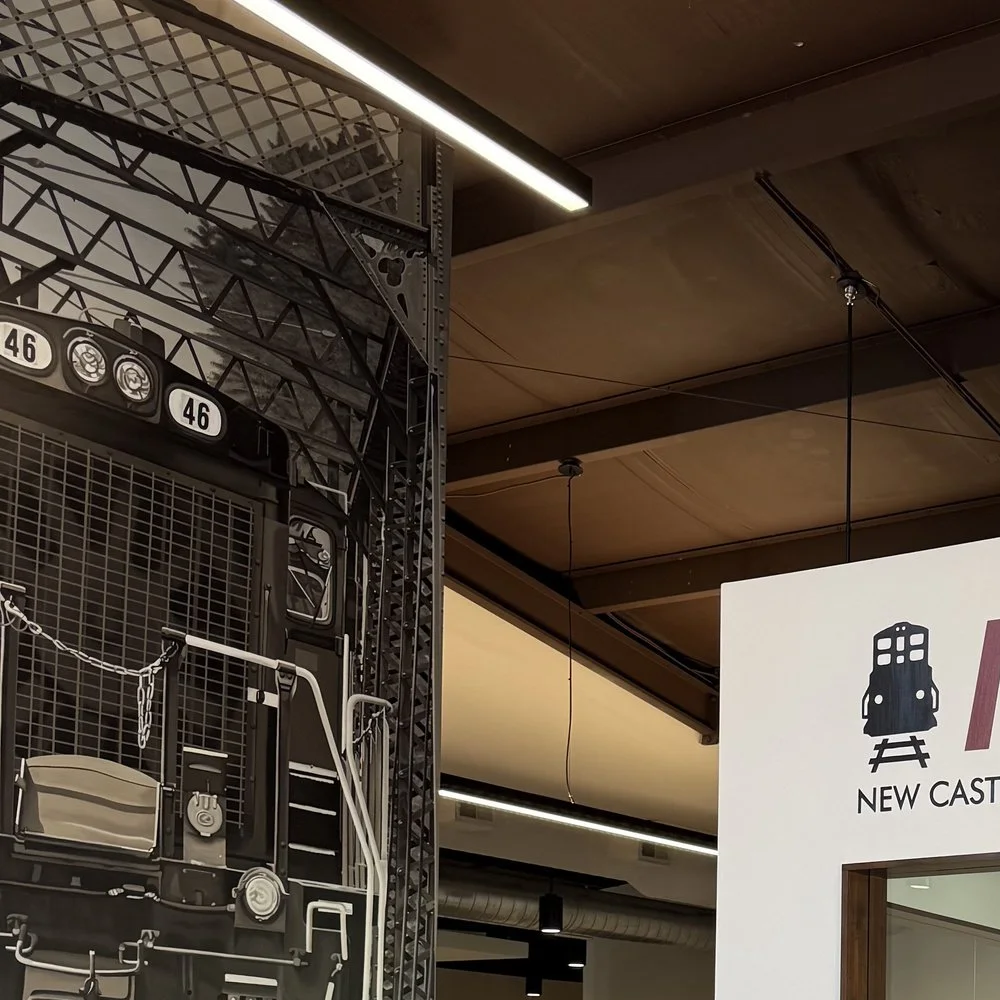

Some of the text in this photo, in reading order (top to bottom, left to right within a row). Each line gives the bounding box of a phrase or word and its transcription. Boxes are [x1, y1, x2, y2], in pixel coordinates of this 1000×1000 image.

[4, 328, 36, 363] 46
[182, 397, 210, 431] 46
[857, 783, 920, 814] NEW
